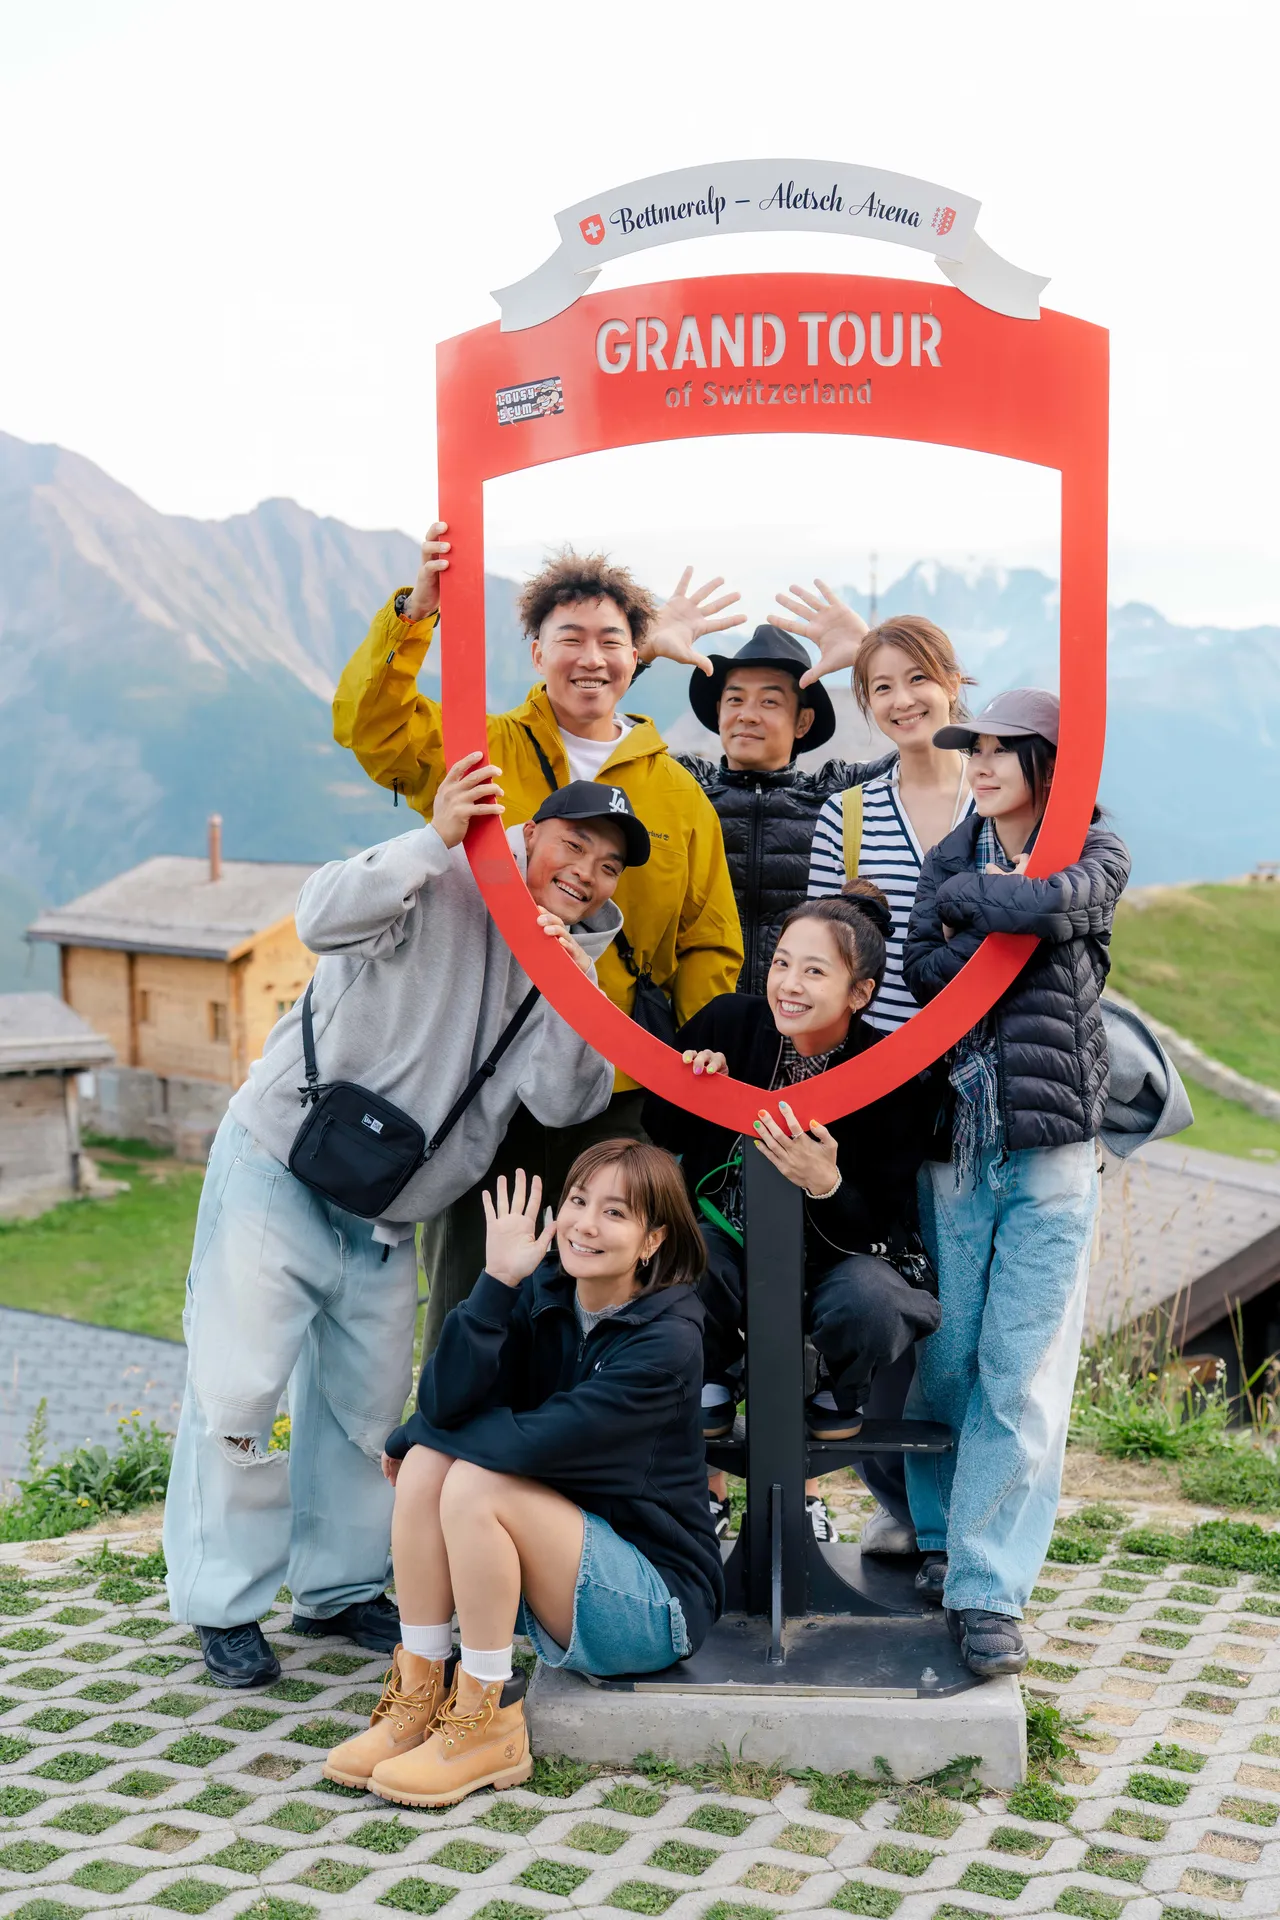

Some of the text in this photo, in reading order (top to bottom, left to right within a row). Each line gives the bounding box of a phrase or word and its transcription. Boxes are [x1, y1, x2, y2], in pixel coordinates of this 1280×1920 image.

[609, 185, 726, 235] Bettmeralp
[758, 180, 845, 212] Aletsch
[848, 191, 923, 228] Arena
[594, 310, 943, 375] GRAND TOUR
[498, 388, 535, 406] LOUSY
[665, 377, 873, 408] of Switzerland
[609, 788, 629, 814] LA
